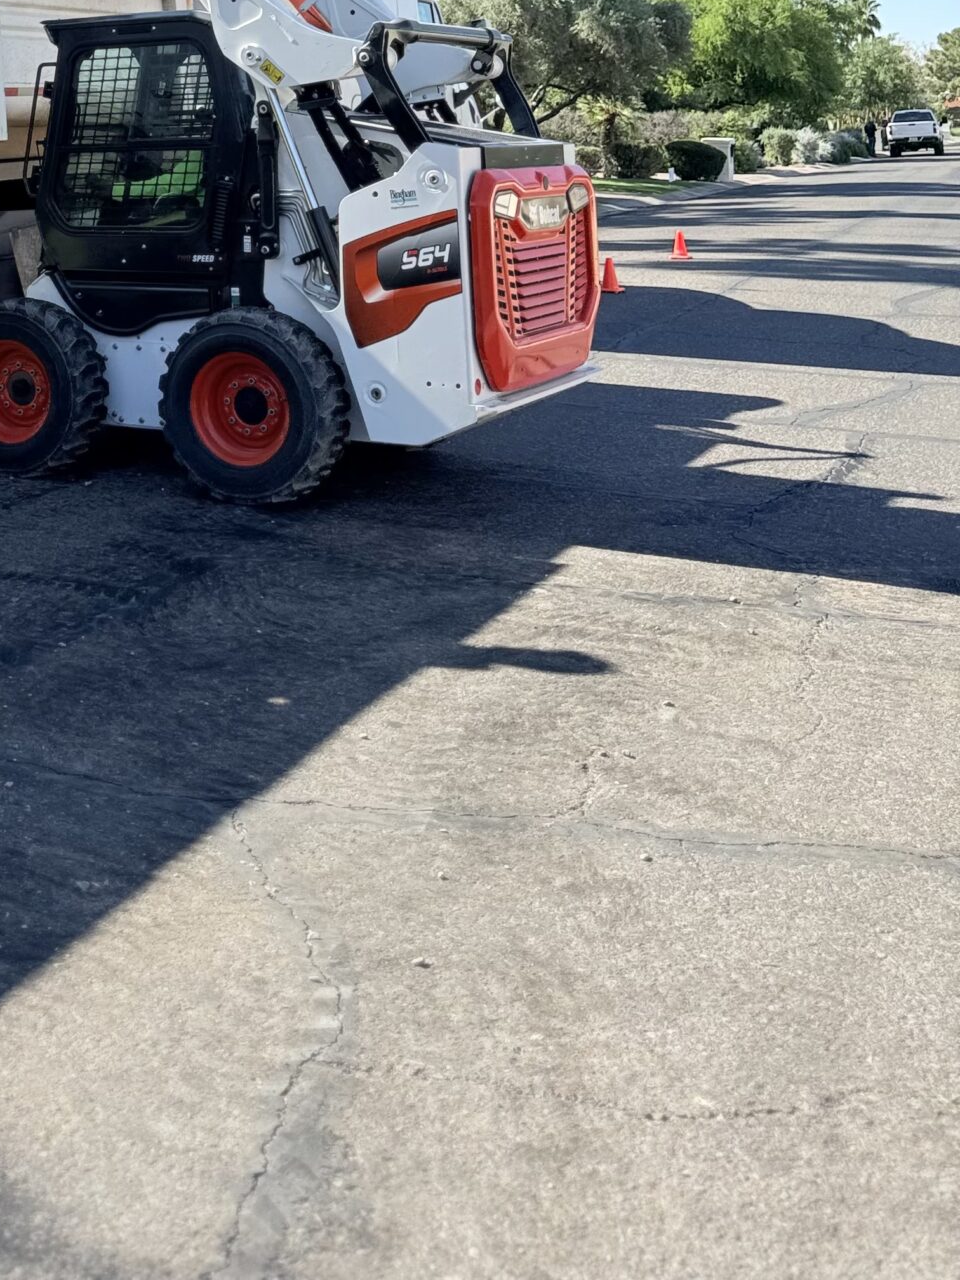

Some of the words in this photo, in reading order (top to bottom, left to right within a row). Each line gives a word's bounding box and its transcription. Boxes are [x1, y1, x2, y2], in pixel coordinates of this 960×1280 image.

[390, 189, 417, 205] Bingham
[539, 204, 560, 225] Bobcat
[192, 254, 215, 263] SPEED
[401, 243, 451, 270] S64
